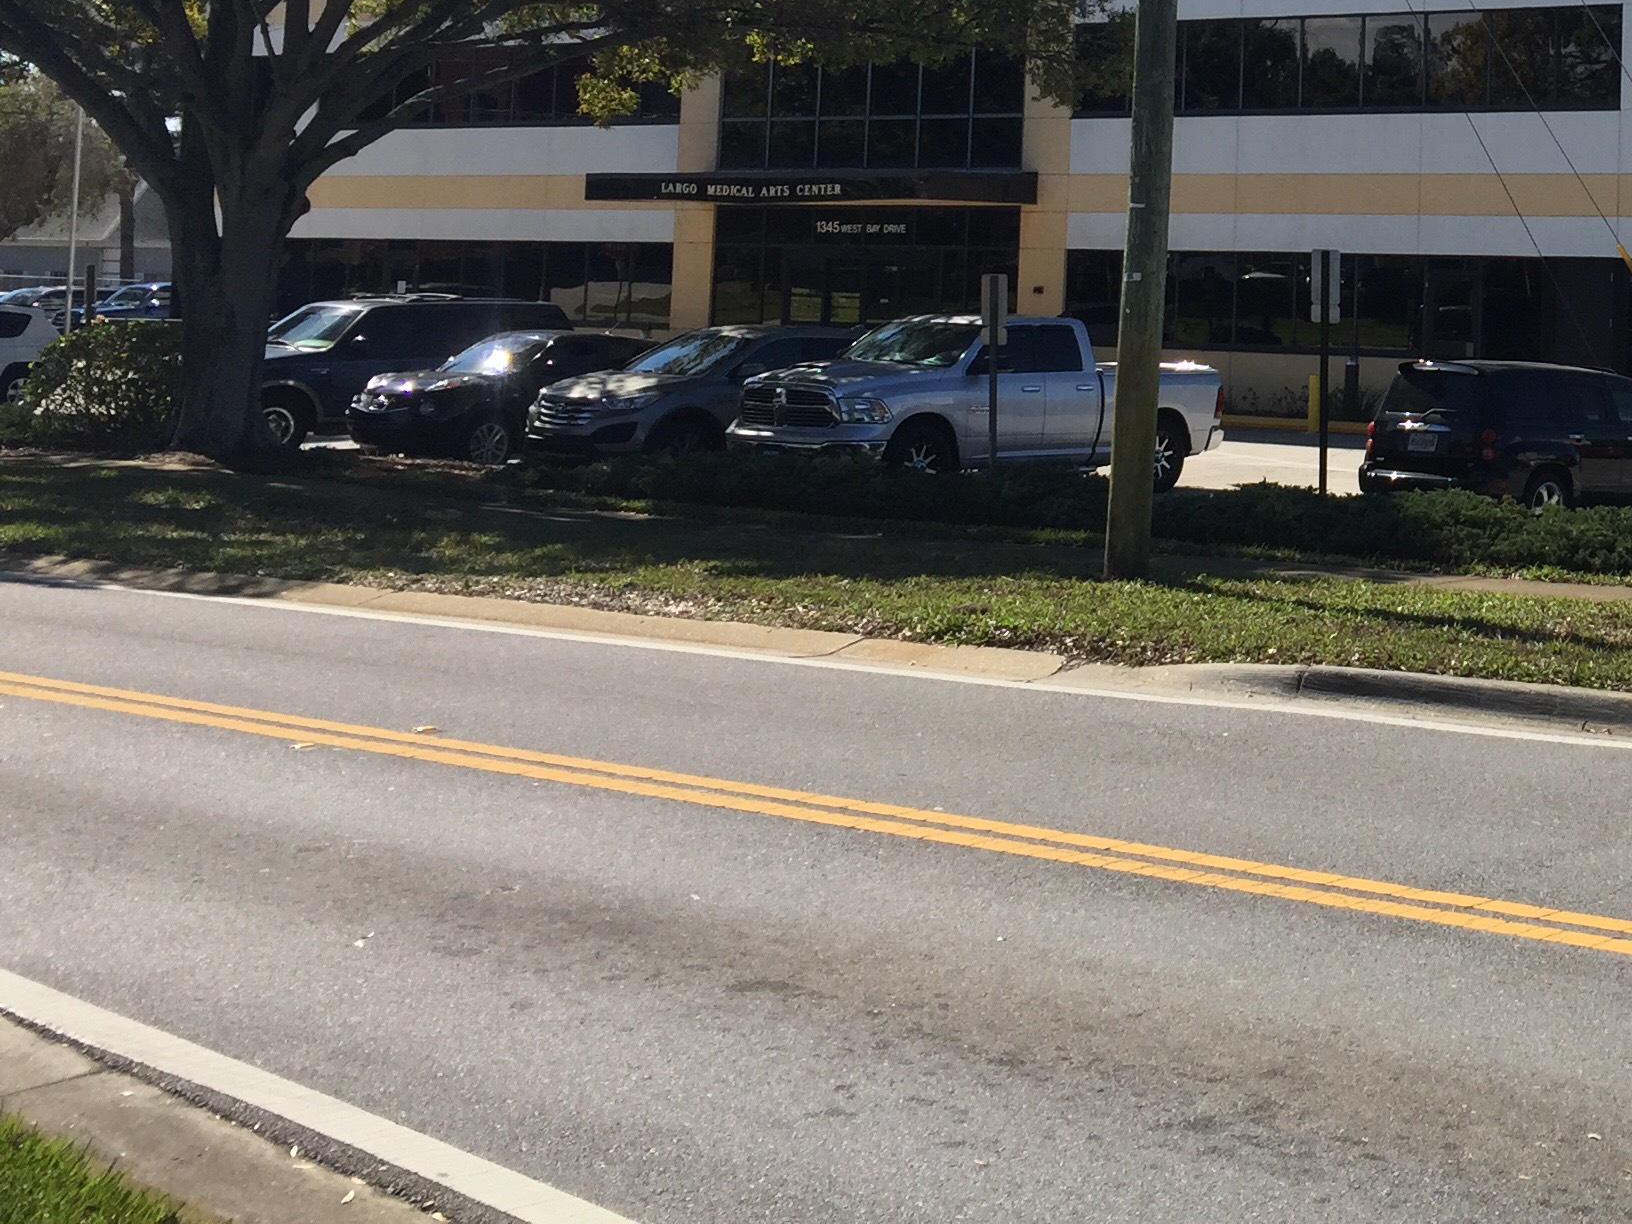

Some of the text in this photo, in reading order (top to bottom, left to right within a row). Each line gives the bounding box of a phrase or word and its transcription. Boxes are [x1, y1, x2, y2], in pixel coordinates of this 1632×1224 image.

[661, 182, 842, 197] LARGO MEDICAL ARTS CENTER
[815, 221, 907, 234] 1345 WEST BAY DRIVE
